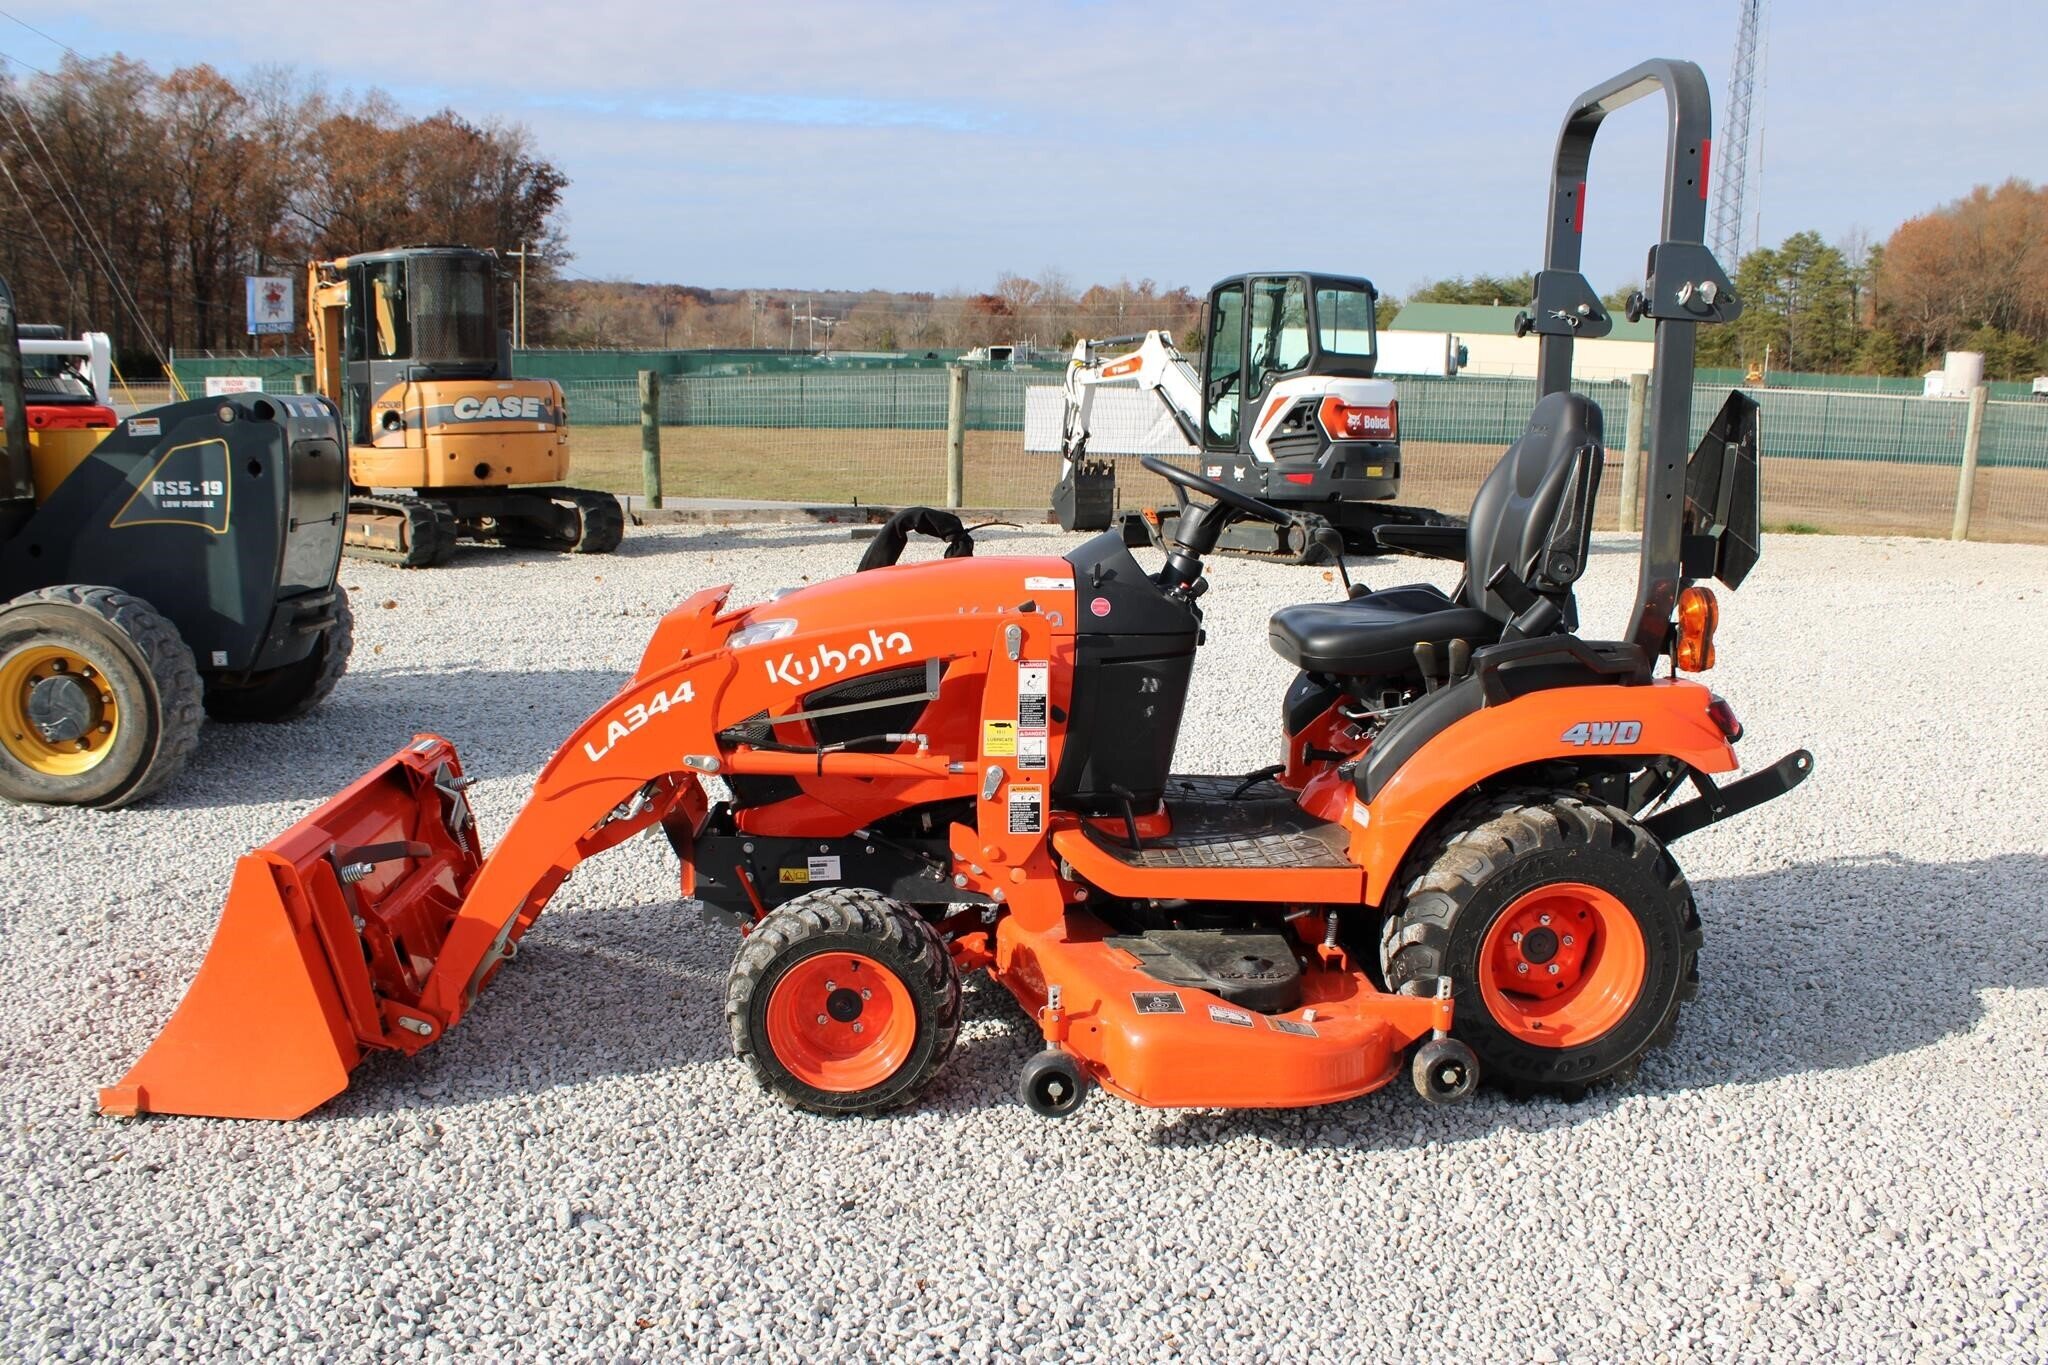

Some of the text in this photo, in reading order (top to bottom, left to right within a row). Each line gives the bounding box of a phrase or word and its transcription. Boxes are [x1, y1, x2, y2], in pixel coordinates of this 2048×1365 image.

[454, 395, 540, 420] CASE
[1364, 415, 1390, 429] Bobcat
[152, 480, 224, 496] RS5-19
[162, 500, 215, 508] LOW PROFILE
[765, 629, 913, 686] Kubota
[583, 680, 696, 762] LA344
[1560, 720, 1643, 746] 4WD
